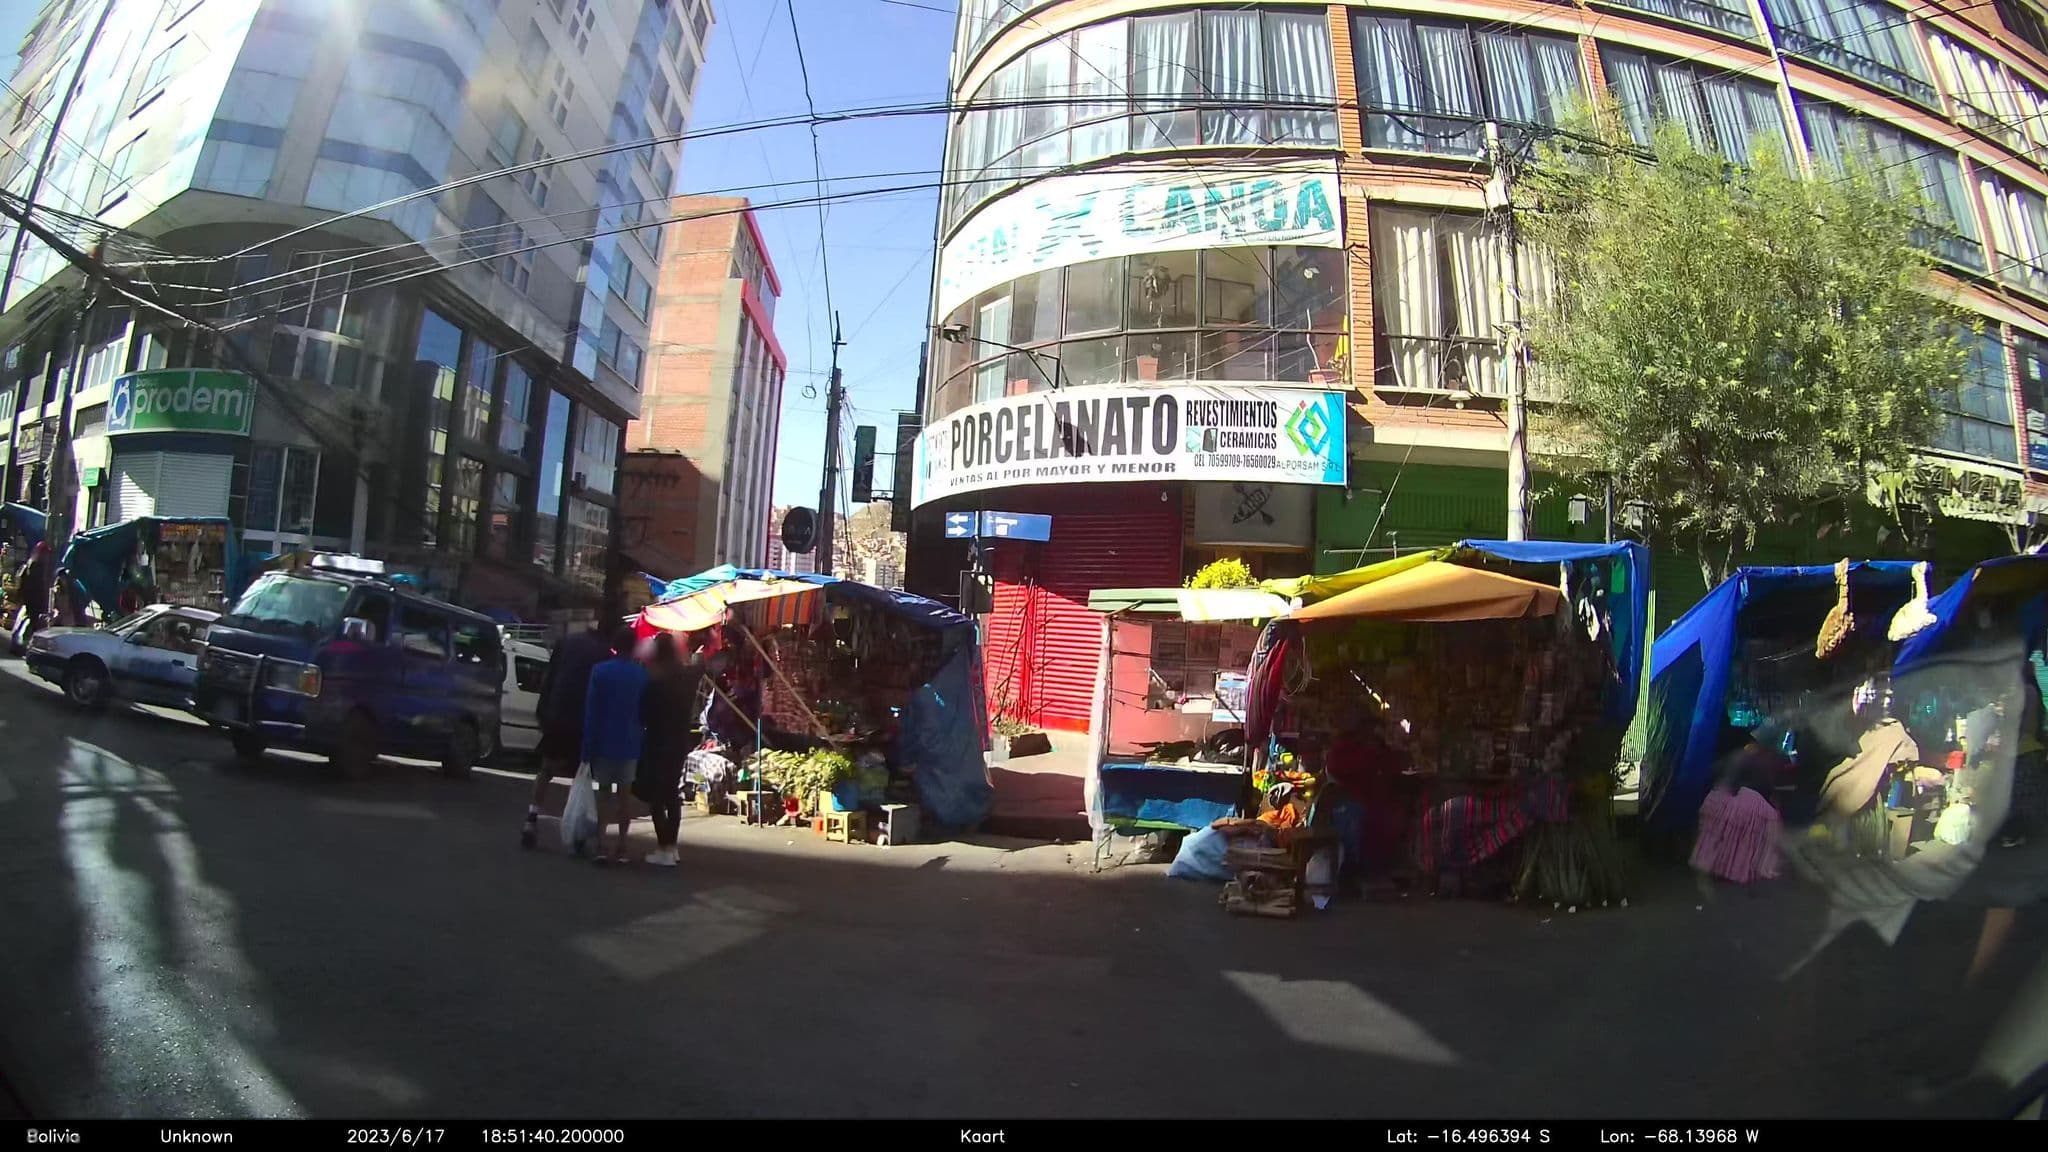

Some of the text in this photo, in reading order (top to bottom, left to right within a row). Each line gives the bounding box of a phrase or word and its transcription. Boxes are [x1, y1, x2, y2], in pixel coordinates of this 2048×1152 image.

[134, 372, 244, 424] prodem
[1186, 400, 1278, 428] REVESTIMIENTOS
[951, 394, 1179, 471] PORCELANATO
[950, 462, 1177, 487] VENTAS AL POR MAYOR Y MENOR
